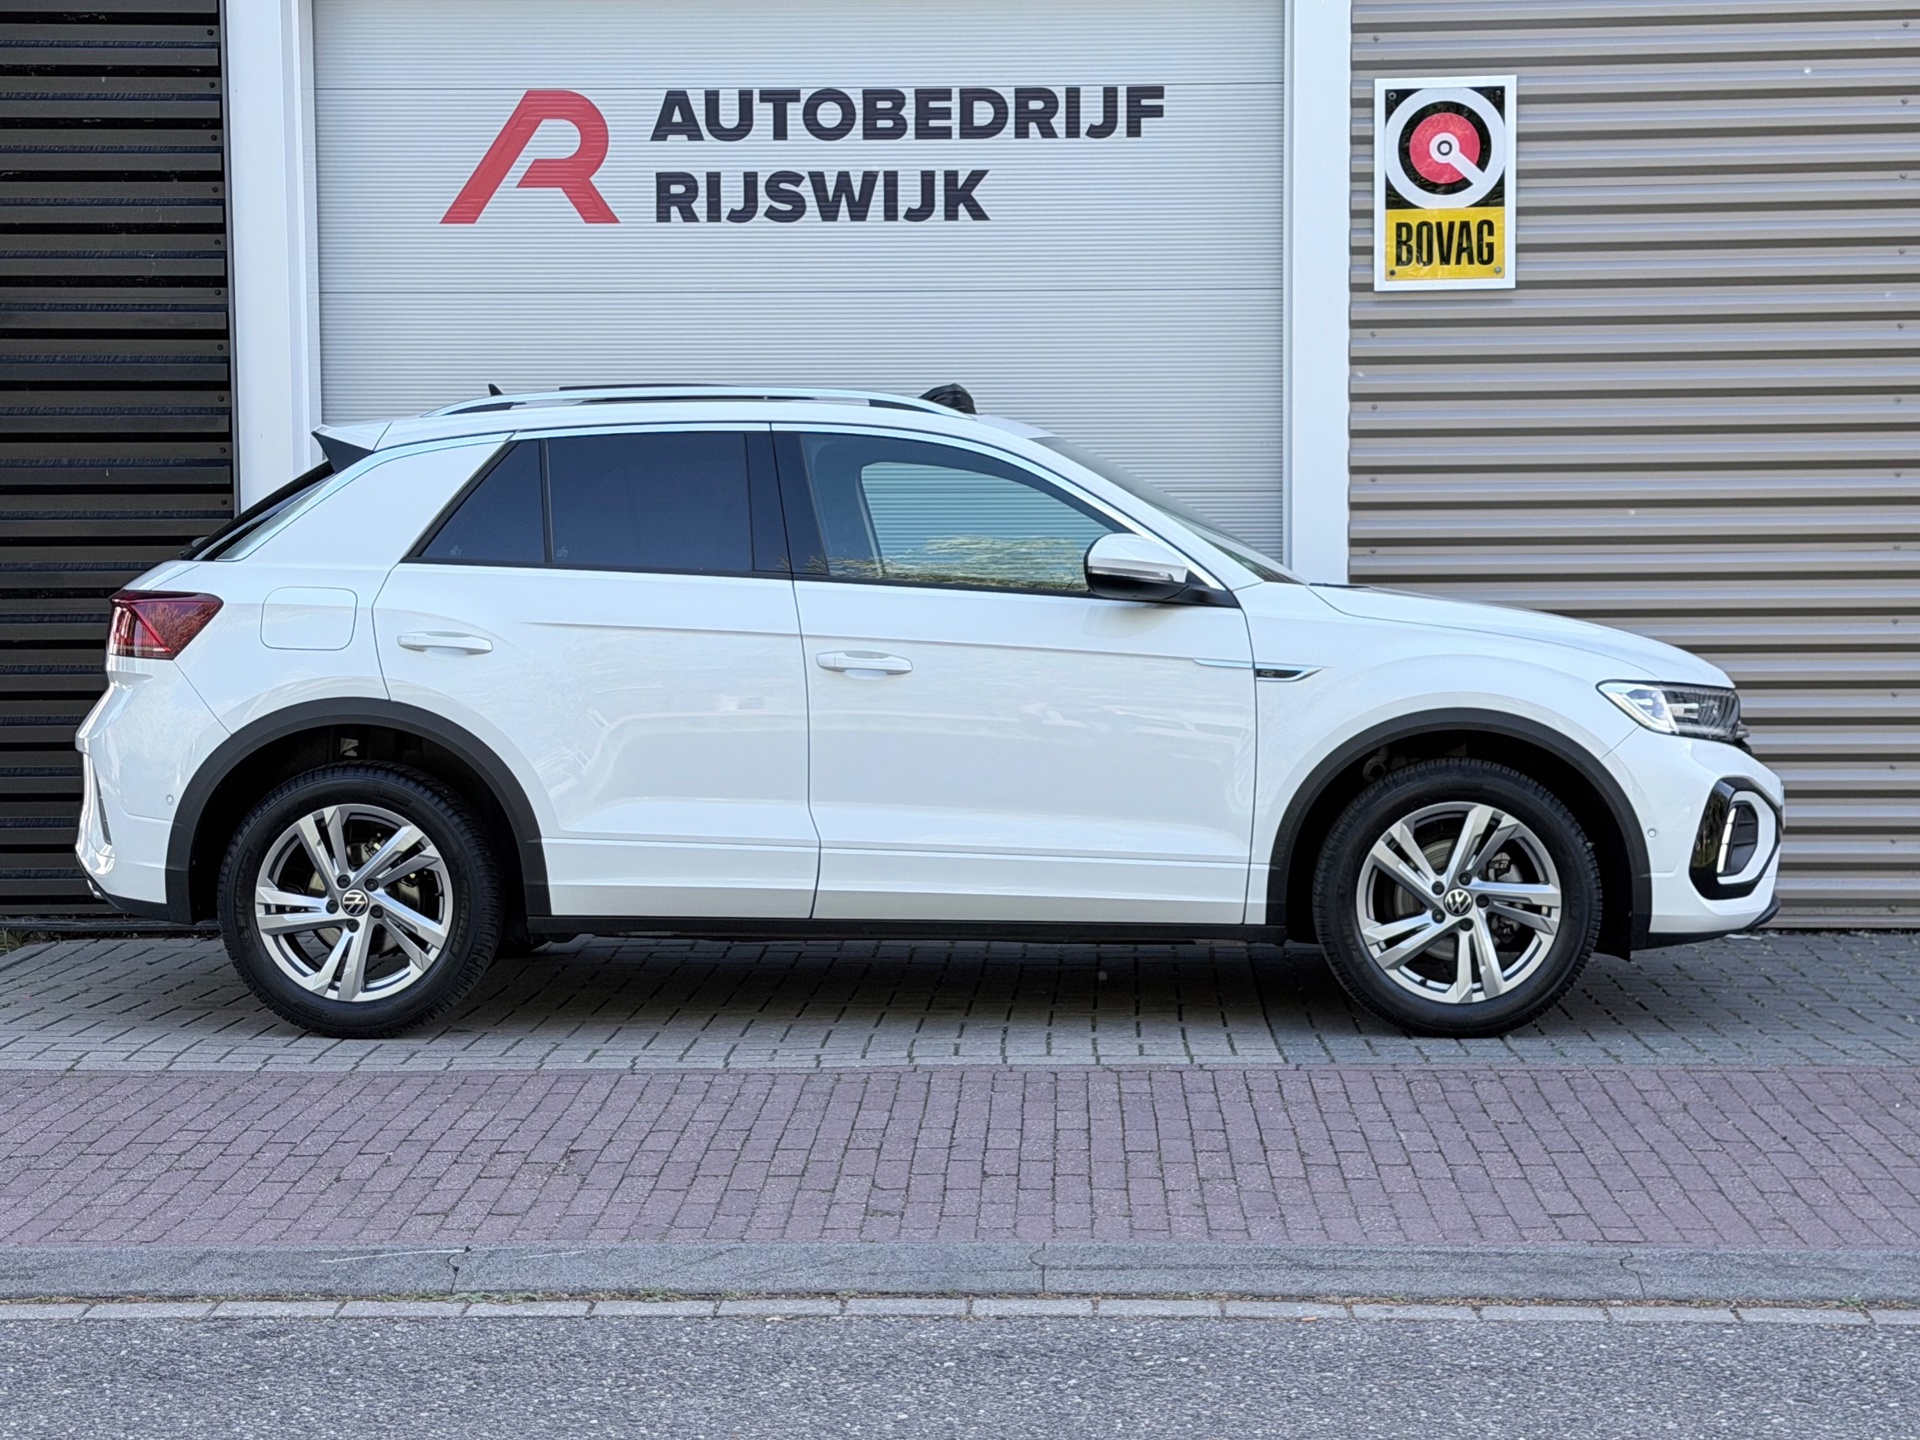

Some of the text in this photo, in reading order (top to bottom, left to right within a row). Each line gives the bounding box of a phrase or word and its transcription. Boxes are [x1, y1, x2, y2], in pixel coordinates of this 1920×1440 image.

[650, 85, 1165, 141] AUTOBEDRIJF
[655, 169, 991, 223] RIJSWIJK
[1395, 219, 1495, 267] BOVAG
